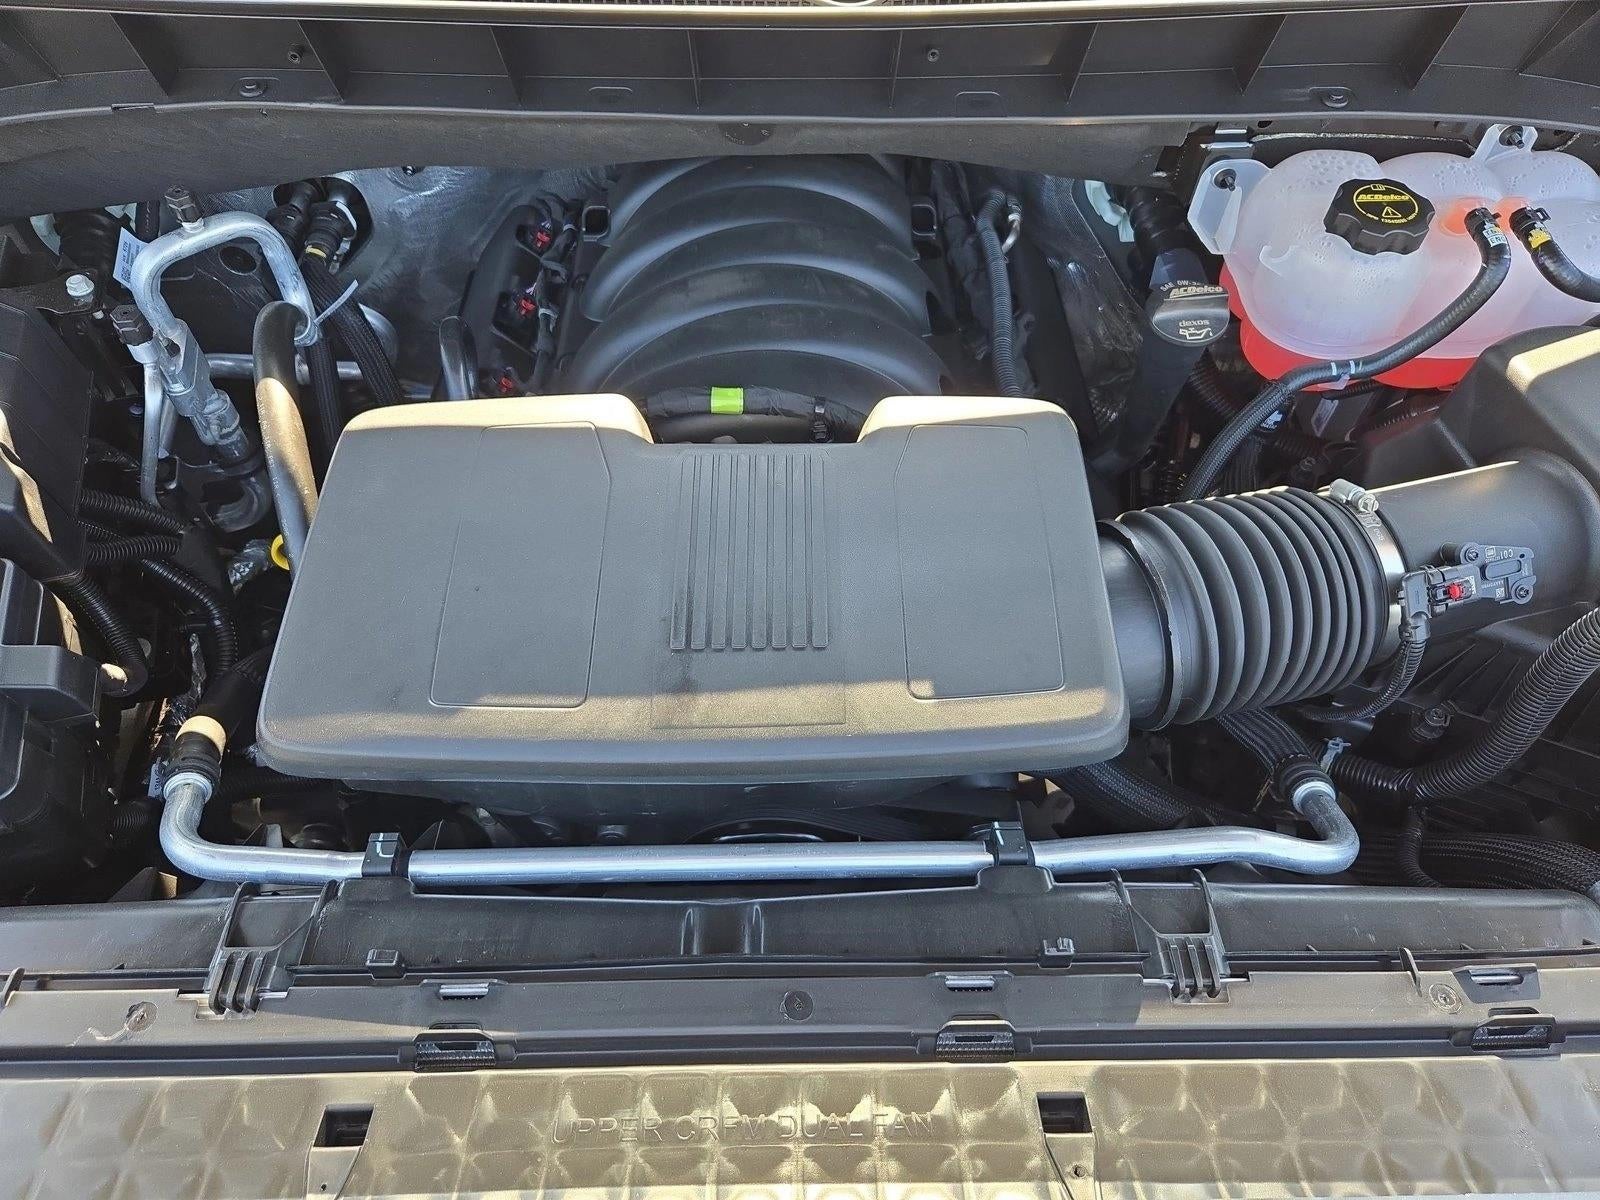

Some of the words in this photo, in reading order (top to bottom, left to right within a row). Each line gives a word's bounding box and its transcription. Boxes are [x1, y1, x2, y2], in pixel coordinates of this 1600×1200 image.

[1357, 193, 1410, 201] ACDelco
[1169, 285, 1223, 298] ACDelco
[1179, 319, 1210, 327] dexos
[551, 1115, 663, 1144] UPPER
[777, 1112, 864, 1138] DUAL
[872, 1111, 934, 1137] FAN
